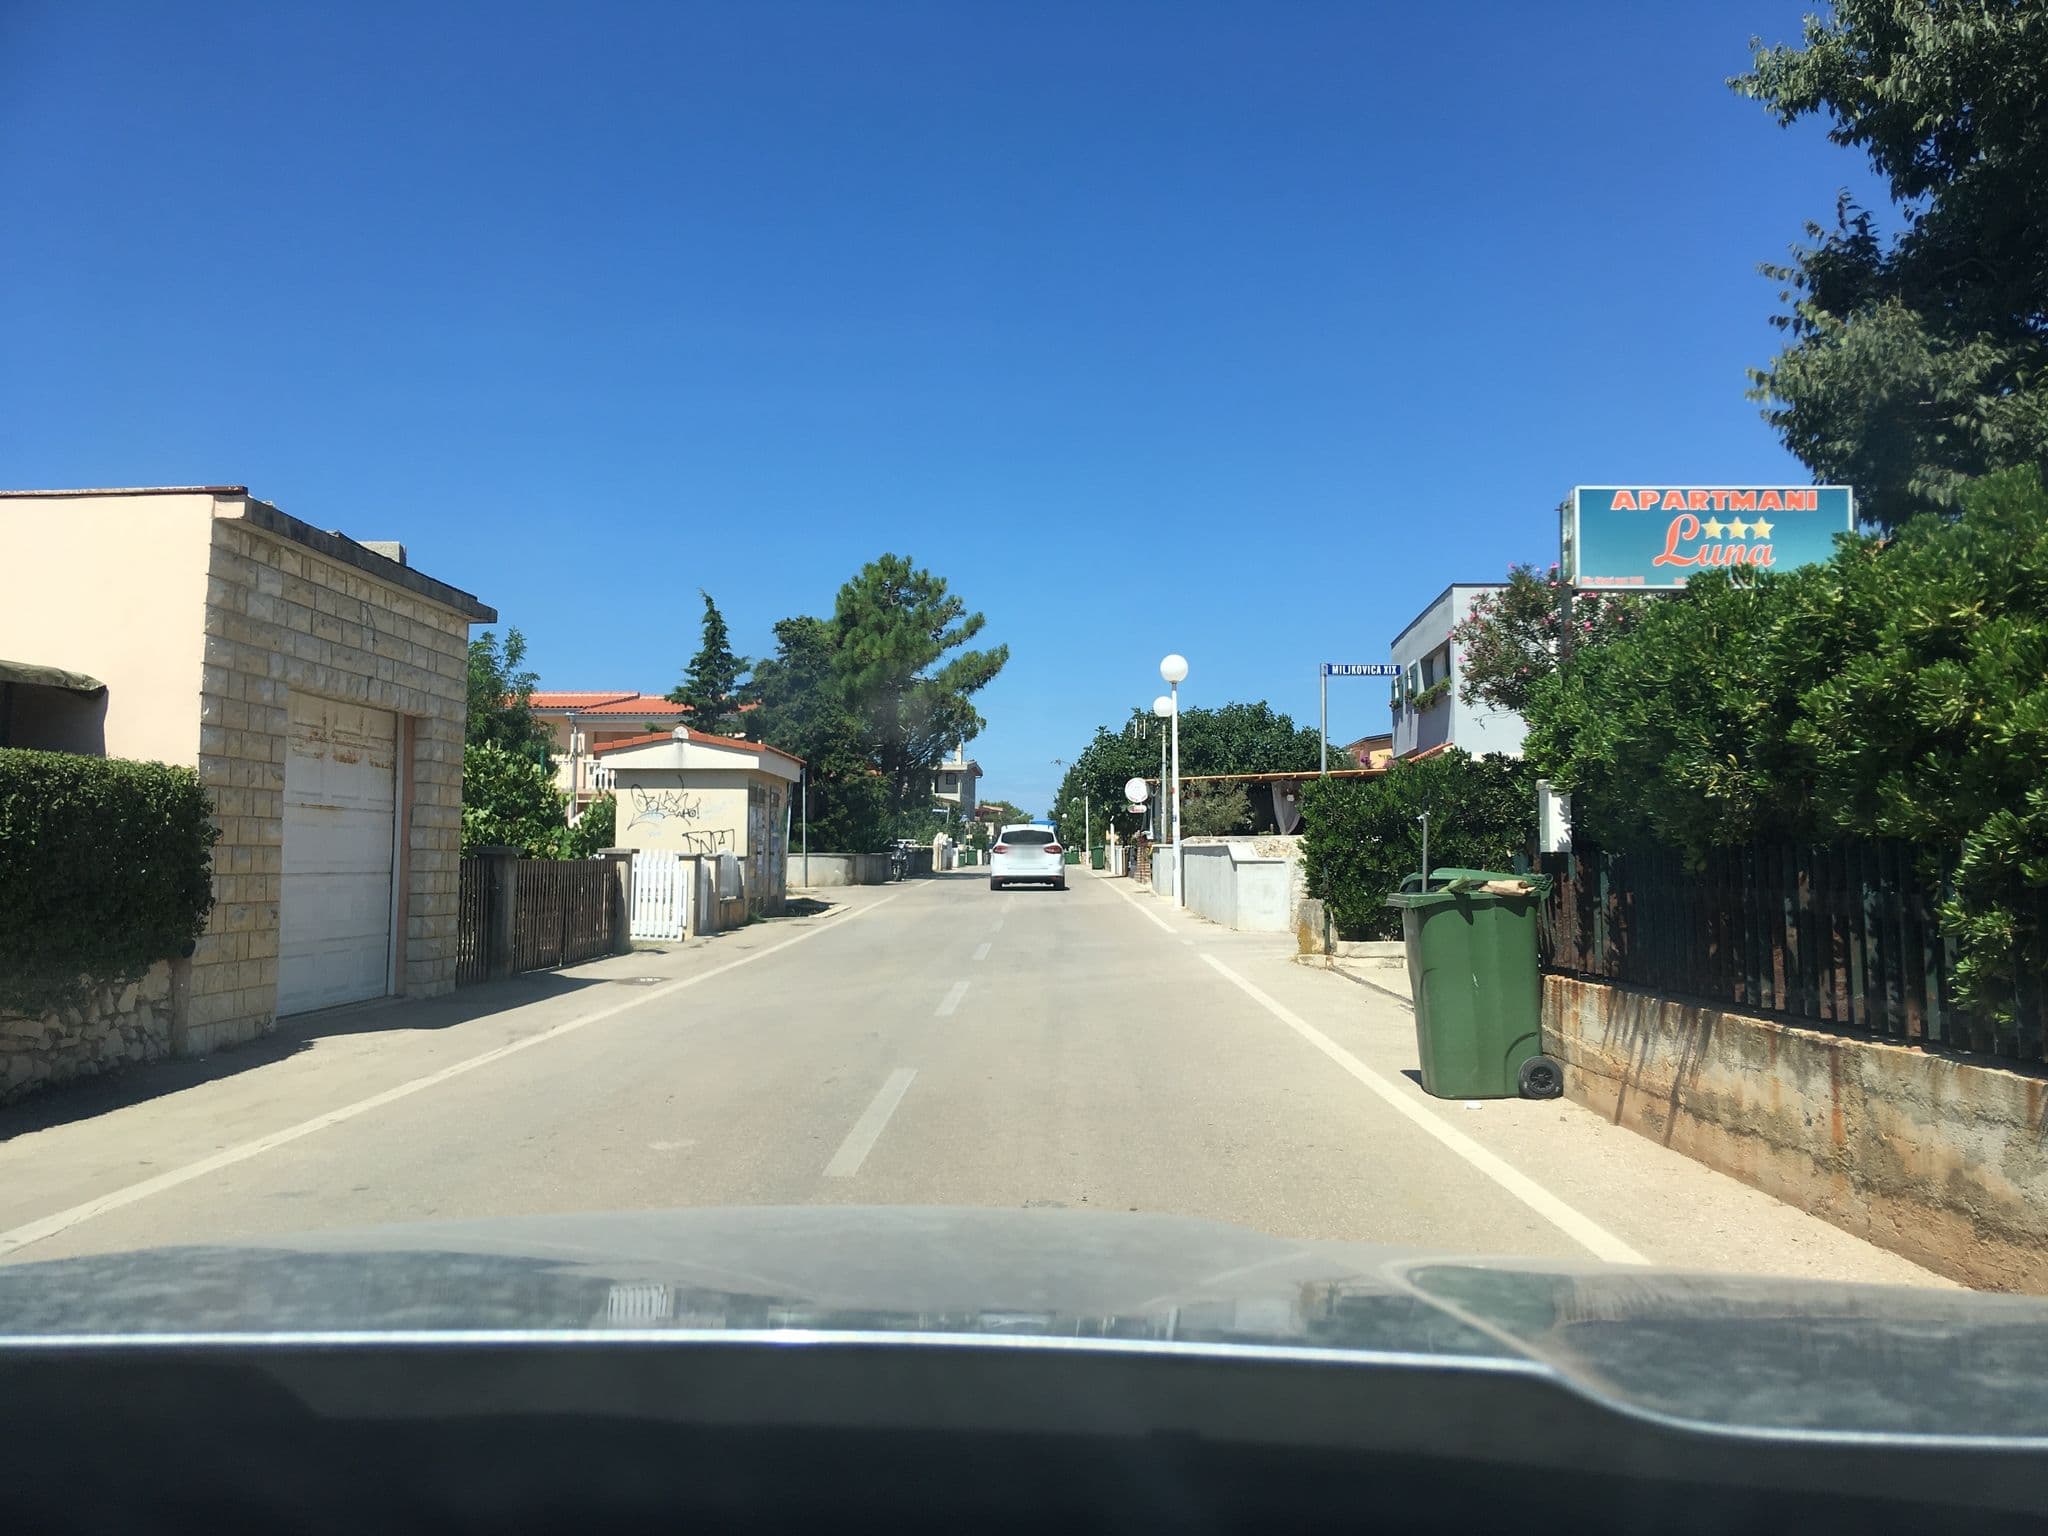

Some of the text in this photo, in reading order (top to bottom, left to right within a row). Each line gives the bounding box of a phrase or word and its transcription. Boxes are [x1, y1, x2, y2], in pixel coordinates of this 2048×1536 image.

[1610, 490, 1818, 511] APARTMANI
[1652, 513, 1777, 567] Luna
[1383, 665, 1397, 675] XIX
